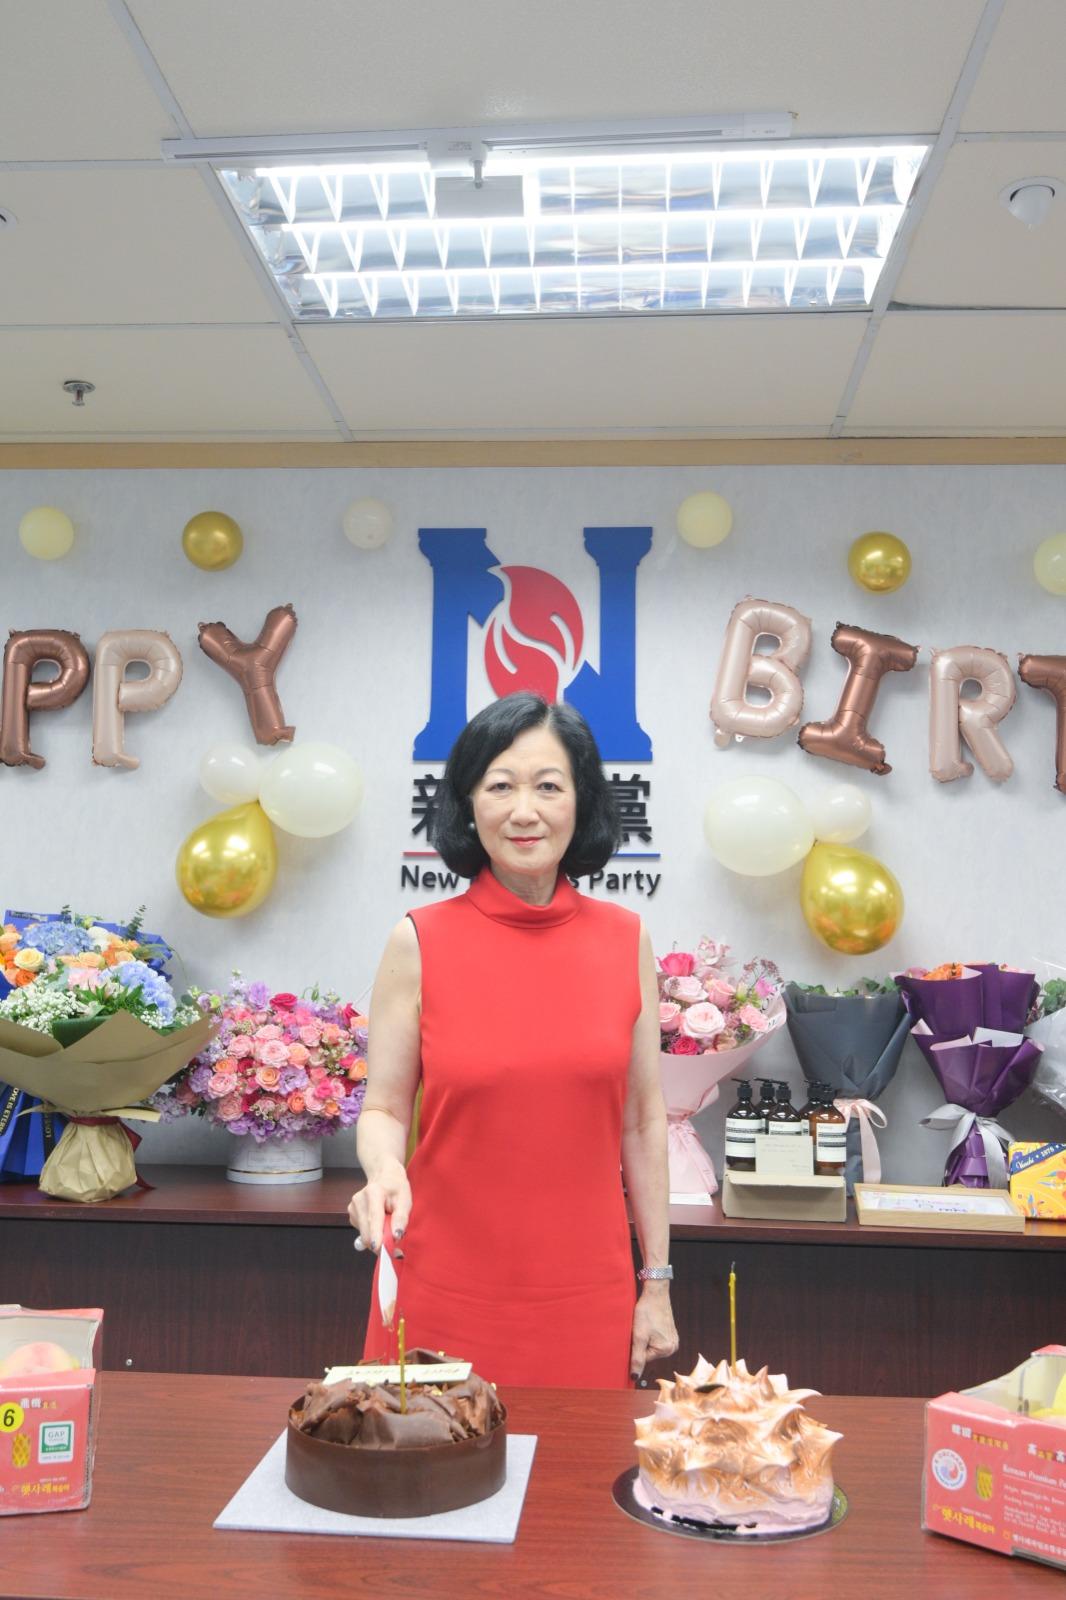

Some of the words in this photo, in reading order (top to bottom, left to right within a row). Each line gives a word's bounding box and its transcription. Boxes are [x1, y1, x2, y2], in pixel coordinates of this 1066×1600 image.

[401, 865, 460, 889] New
[590, 869, 661, 896] Party
[4, 1409, 15, 1426] 6
[47, 1431, 65, 1439] GAP
